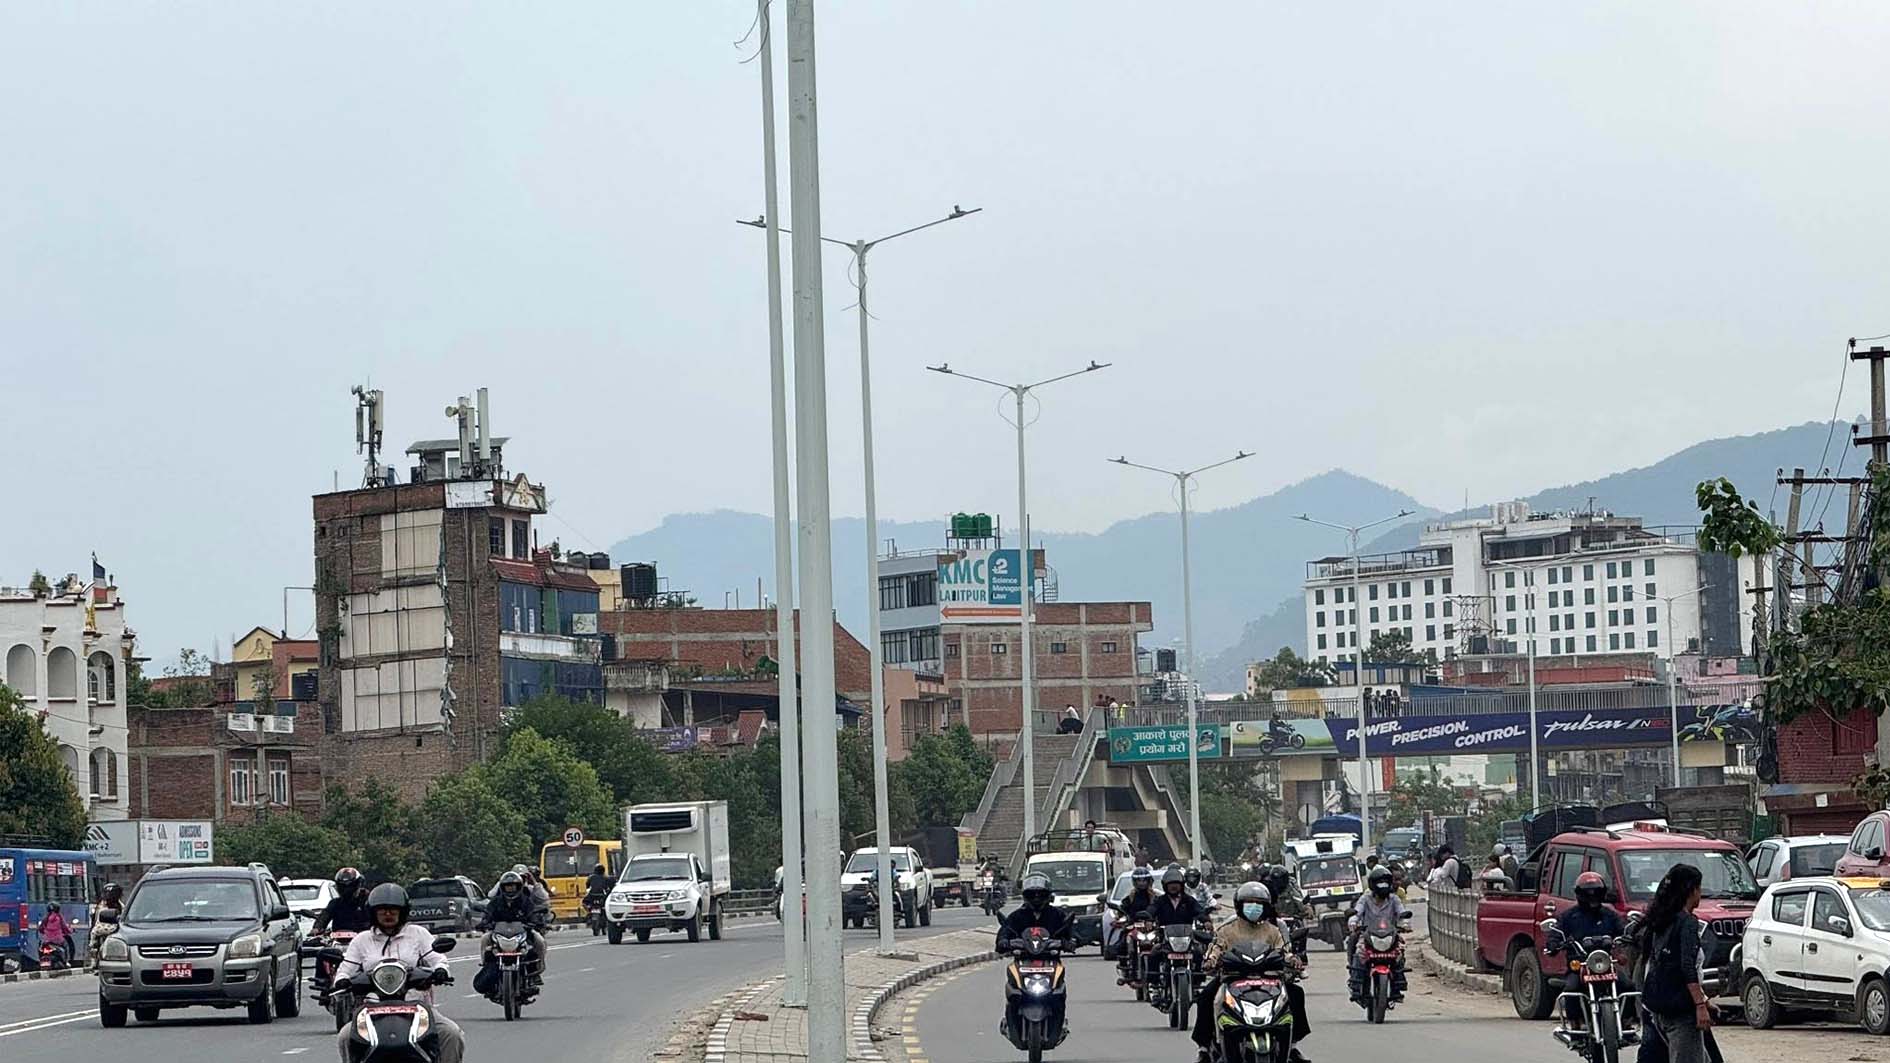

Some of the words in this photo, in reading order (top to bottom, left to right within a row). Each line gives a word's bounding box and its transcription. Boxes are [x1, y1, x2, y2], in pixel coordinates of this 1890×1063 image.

[939, 559, 985, 585] KMC
[940, 590, 986, 601] LAITPUR
[1392, 721, 1469, 746] PRECISION.
[1455, 725, 1526, 748] CONTROL.
[1140, 743, 1165, 755] प्रयोग
[566, 832, 581, 842] 50
[179, 840, 193, 859] OPEN
[408, 909, 443, 917] OYOTA
